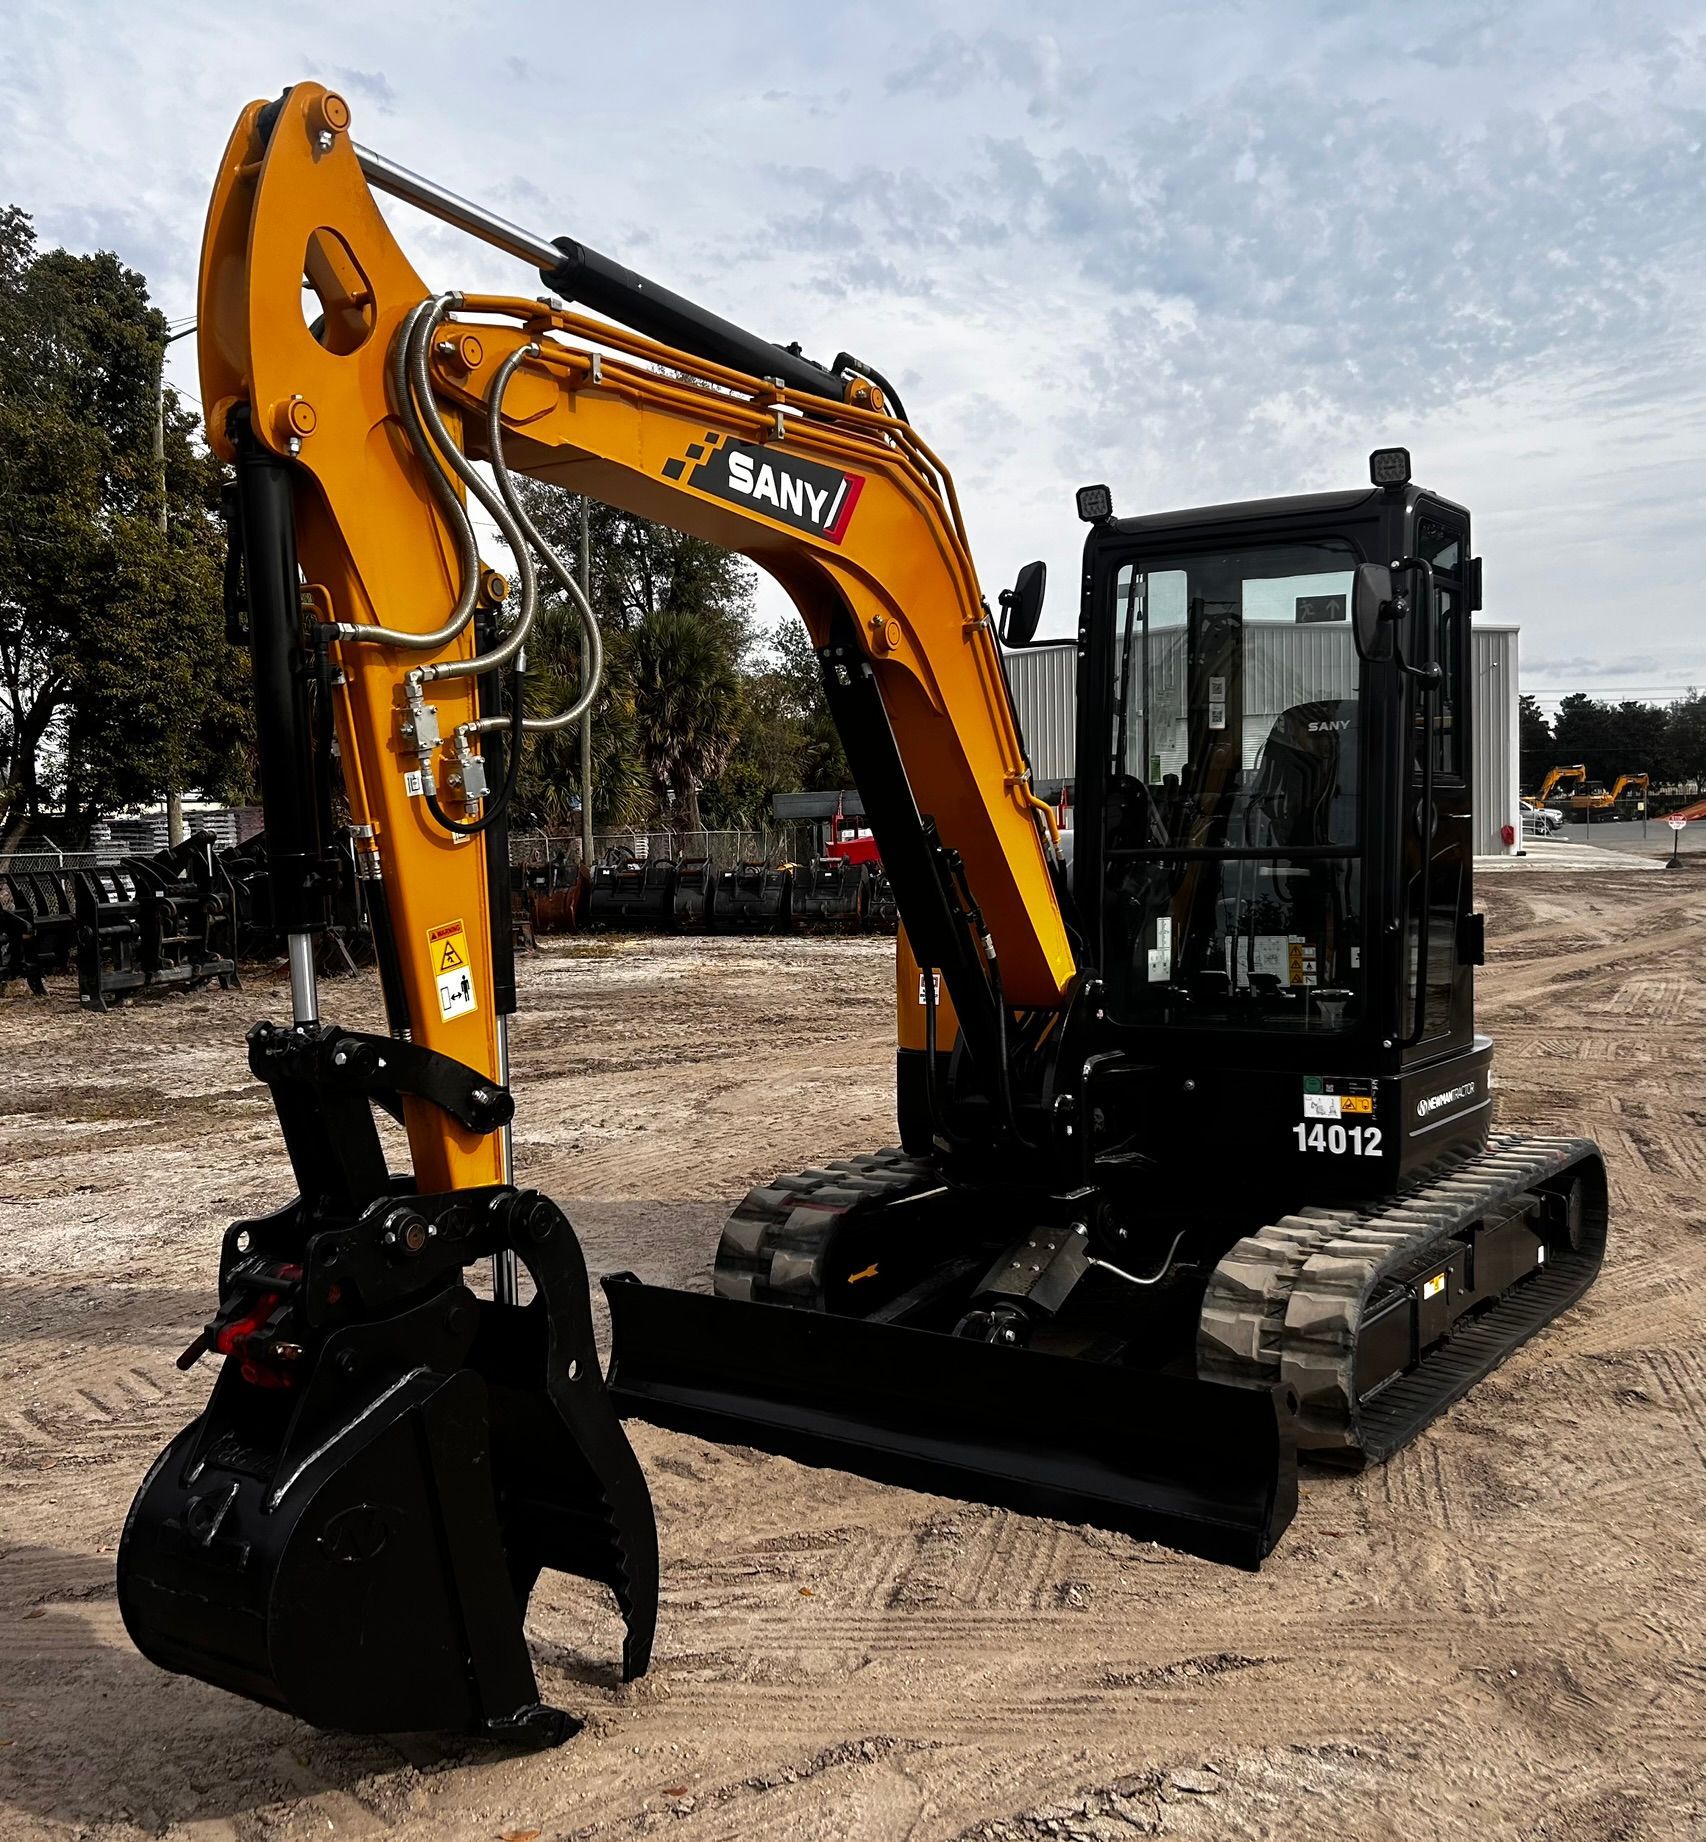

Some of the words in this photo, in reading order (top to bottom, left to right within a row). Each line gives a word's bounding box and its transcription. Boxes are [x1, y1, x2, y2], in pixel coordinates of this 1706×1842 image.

[728, 450, 829, 524] SANY
[1307, 719, 1351, 732] SANY
[1292, 1122, 1383, 1157] 14012
